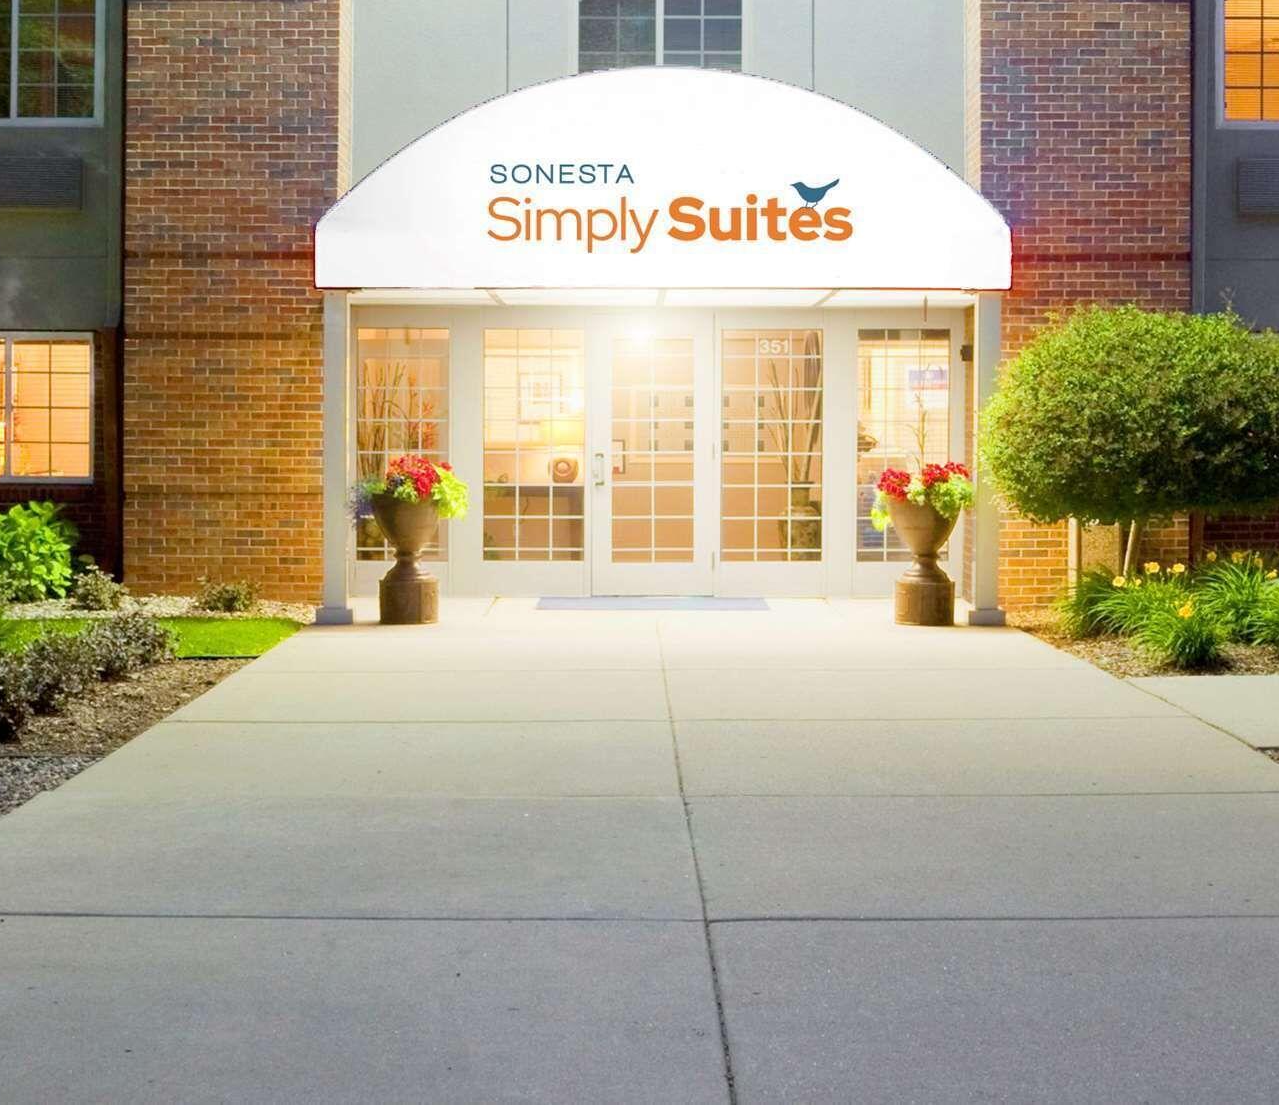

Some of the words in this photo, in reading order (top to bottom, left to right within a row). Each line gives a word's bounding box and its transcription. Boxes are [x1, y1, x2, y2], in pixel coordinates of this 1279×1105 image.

[489, 162, 635, 185] SONESTA
[486, 196, 660, 255] Simply
[666, 193, 854, 243] Suites
[759, 339, 789, 355] 351
